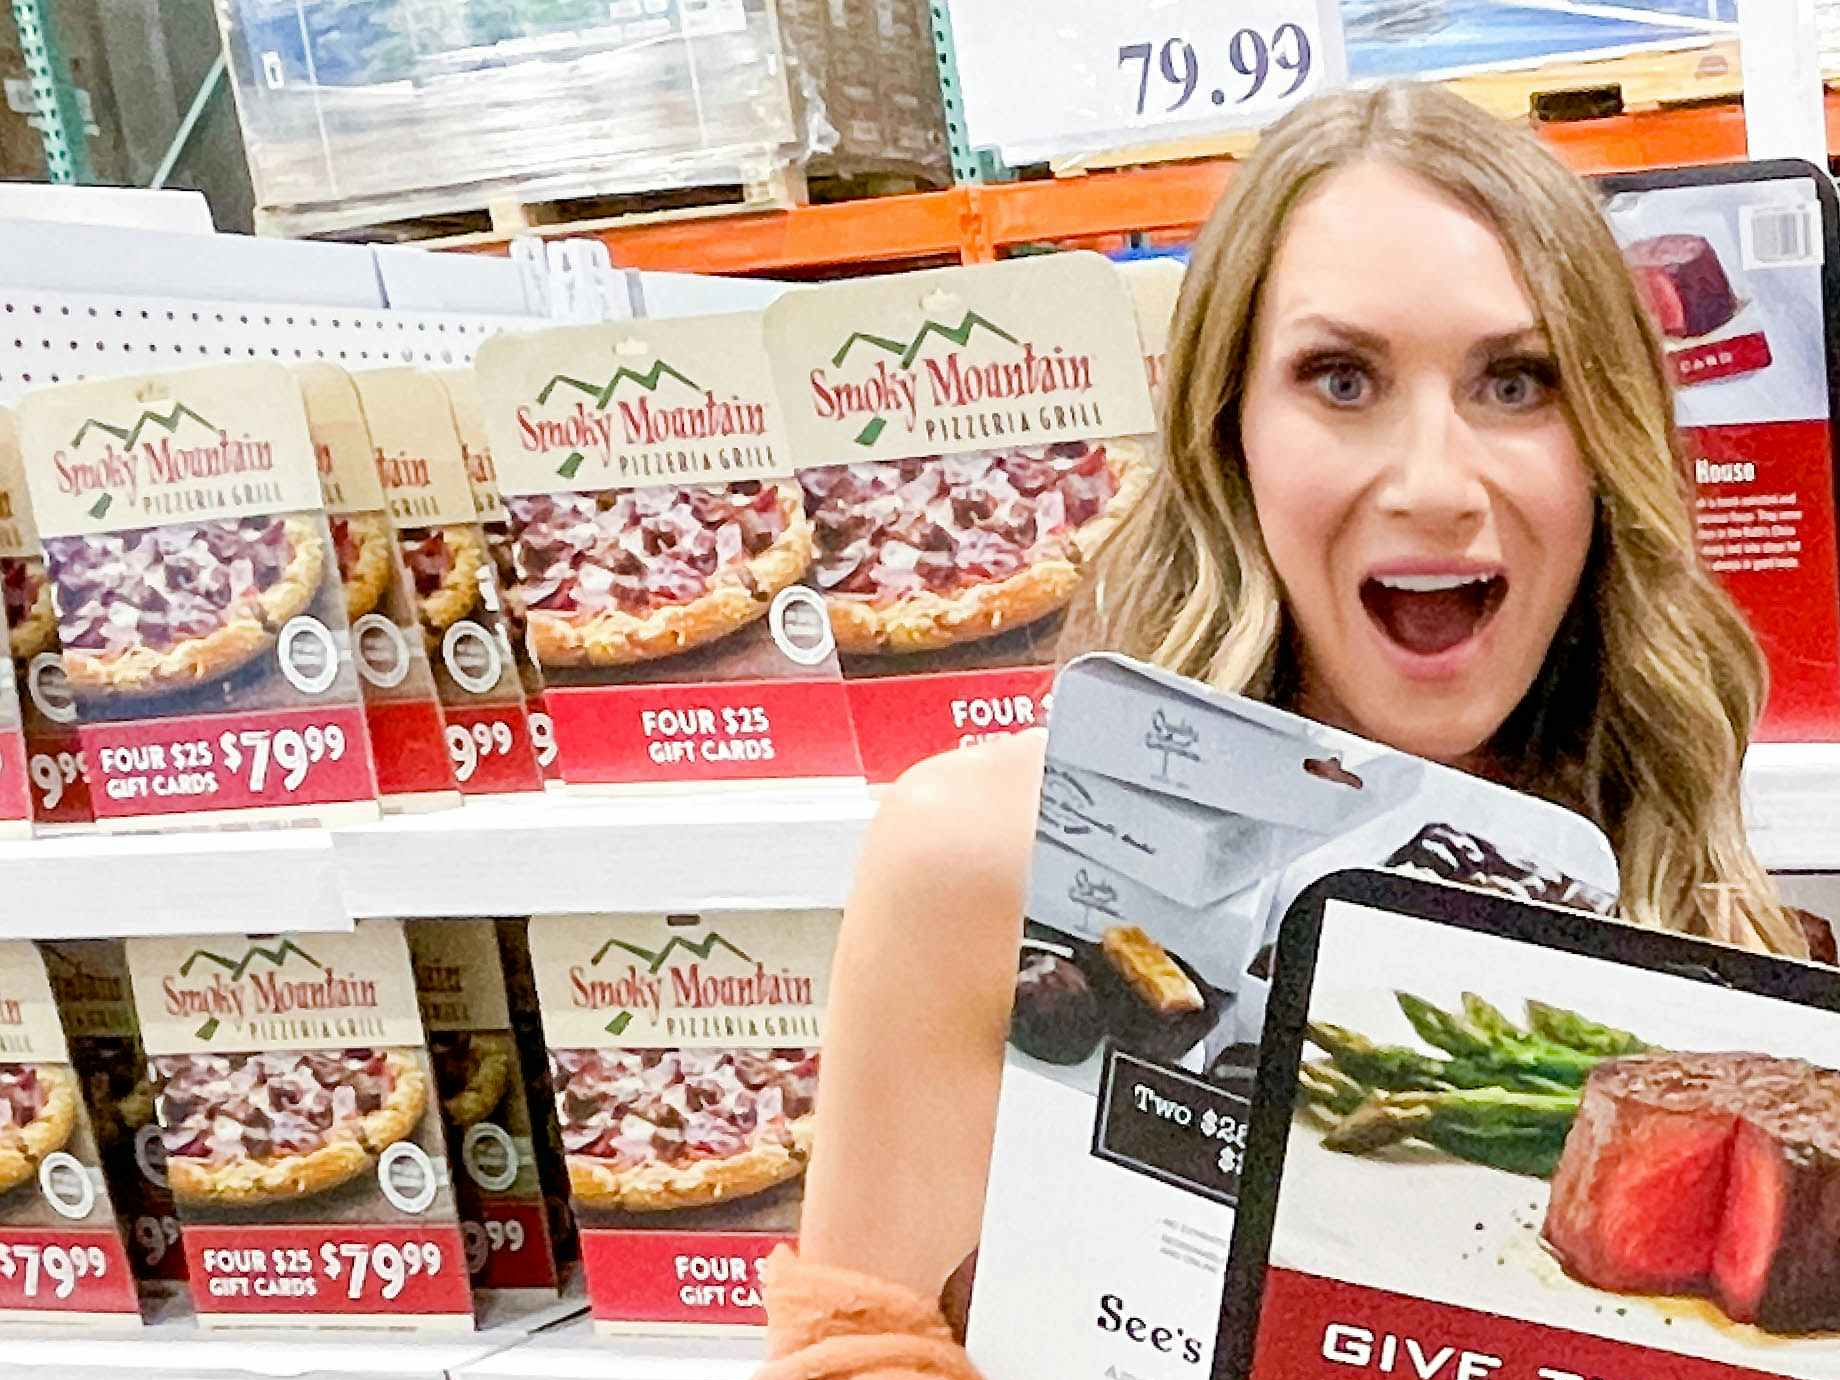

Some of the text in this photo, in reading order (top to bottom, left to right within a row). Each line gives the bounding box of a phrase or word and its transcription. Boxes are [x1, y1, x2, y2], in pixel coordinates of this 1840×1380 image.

[1118, 22, 1312, 114] 79.99
[809, 343, 1093, 433] Smoky Mountain
[516, 389, 766, 467] Smoky Mountain
[924, 403, 1103, 442] PIZZERIA GRILL
[53, 430, 273, 506] Smoky Mountain
[618, 445, 776, 477] PIZZERIA GRILL
[642, 706, 769, 736] FOUR $25
[951, 696, 1037, 726] FOUR
[101, 745, 165, 773] FOUR
[171, 740, 212, 769] $25
[648, 737, 774, 764] GIFT CARDS
[106, 770, 219, 798] GIFT CARDS
[162, 966, 377, 1034] Smoky Mountain
[570, 964, 814, 1029] Smoky Mountain
[1134, 1083, 1191, 1127] Two
[204, 1249, 267, 1274] FOUR
[274, 1249, 312, 1274] $25
[675, 1255, 748, 1282] FOUR
[208, 1275, 317, 1298] GIFT CARDS
[680, 1284, 725, 1307] GIFT
[1096, 1293, 1202, 1364] See's
